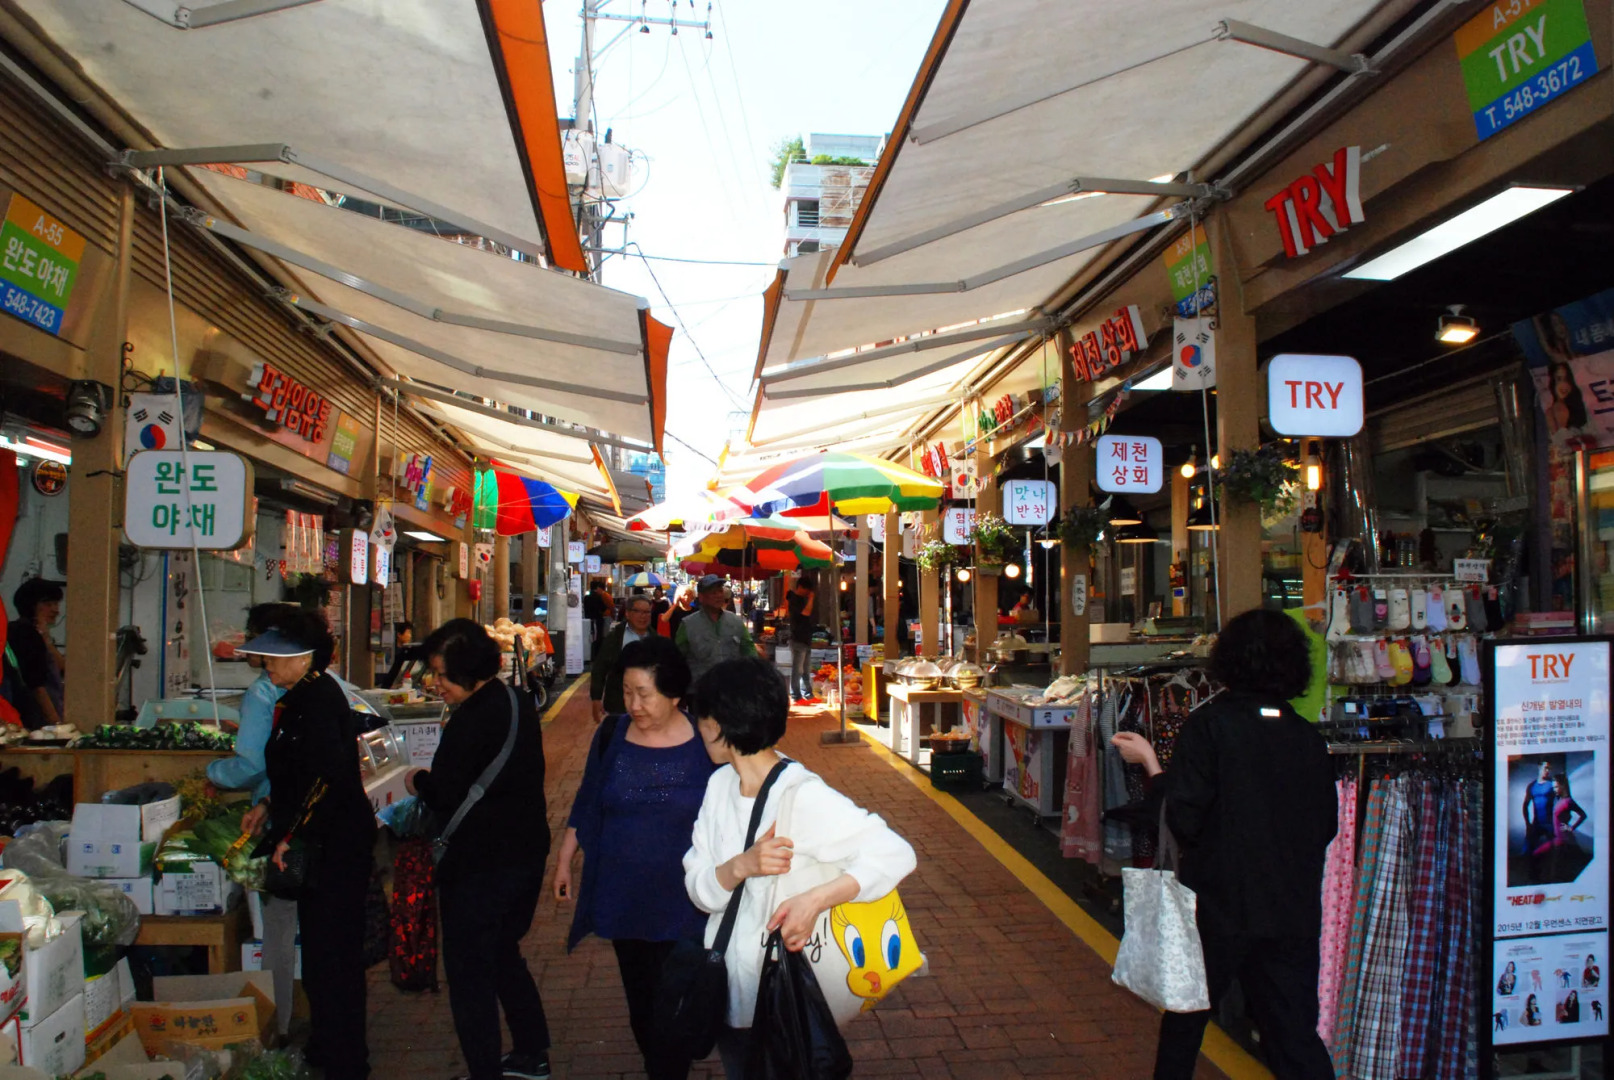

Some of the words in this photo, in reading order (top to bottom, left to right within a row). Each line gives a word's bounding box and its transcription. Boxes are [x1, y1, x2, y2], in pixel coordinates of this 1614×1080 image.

[1488, 14, 1547, 83] TRY
[1485, 106, 1502, 129] T.
[1503, 56, 1583, 120] 548-3672
[1264, 146, 1357, 258] TRY
[33, 214, 64, 246] A-55
[3, 236, 39, 278] 완도
[37, 257, 69, 297] 야채
[4, 288, 56, 328] 548-7423
[1069, 306, 1140, 382] 제천상회
[1285, 379, 1345, 410] TRY
[1111, 441, 1148, 463] 제천
[154, 461, 218, 495] 완도
[1111, 465, 1149, 487] 상회
[1014, 485, 1047, 502] 맛나
[152, 503, 216, 536] 야채
[1015, 504, 1047, 520] 반찬
[1527, 653, 1575, 679] TRY
[1521, 700, 1546, 712] 신개념
[1549, 698, 1583, 711] 발열내의
[1497, 922, 1523, 933] 2015년
[1525, 920, 1541, 931] 12월
[1574, 916, 1603, 927] 지면광고
